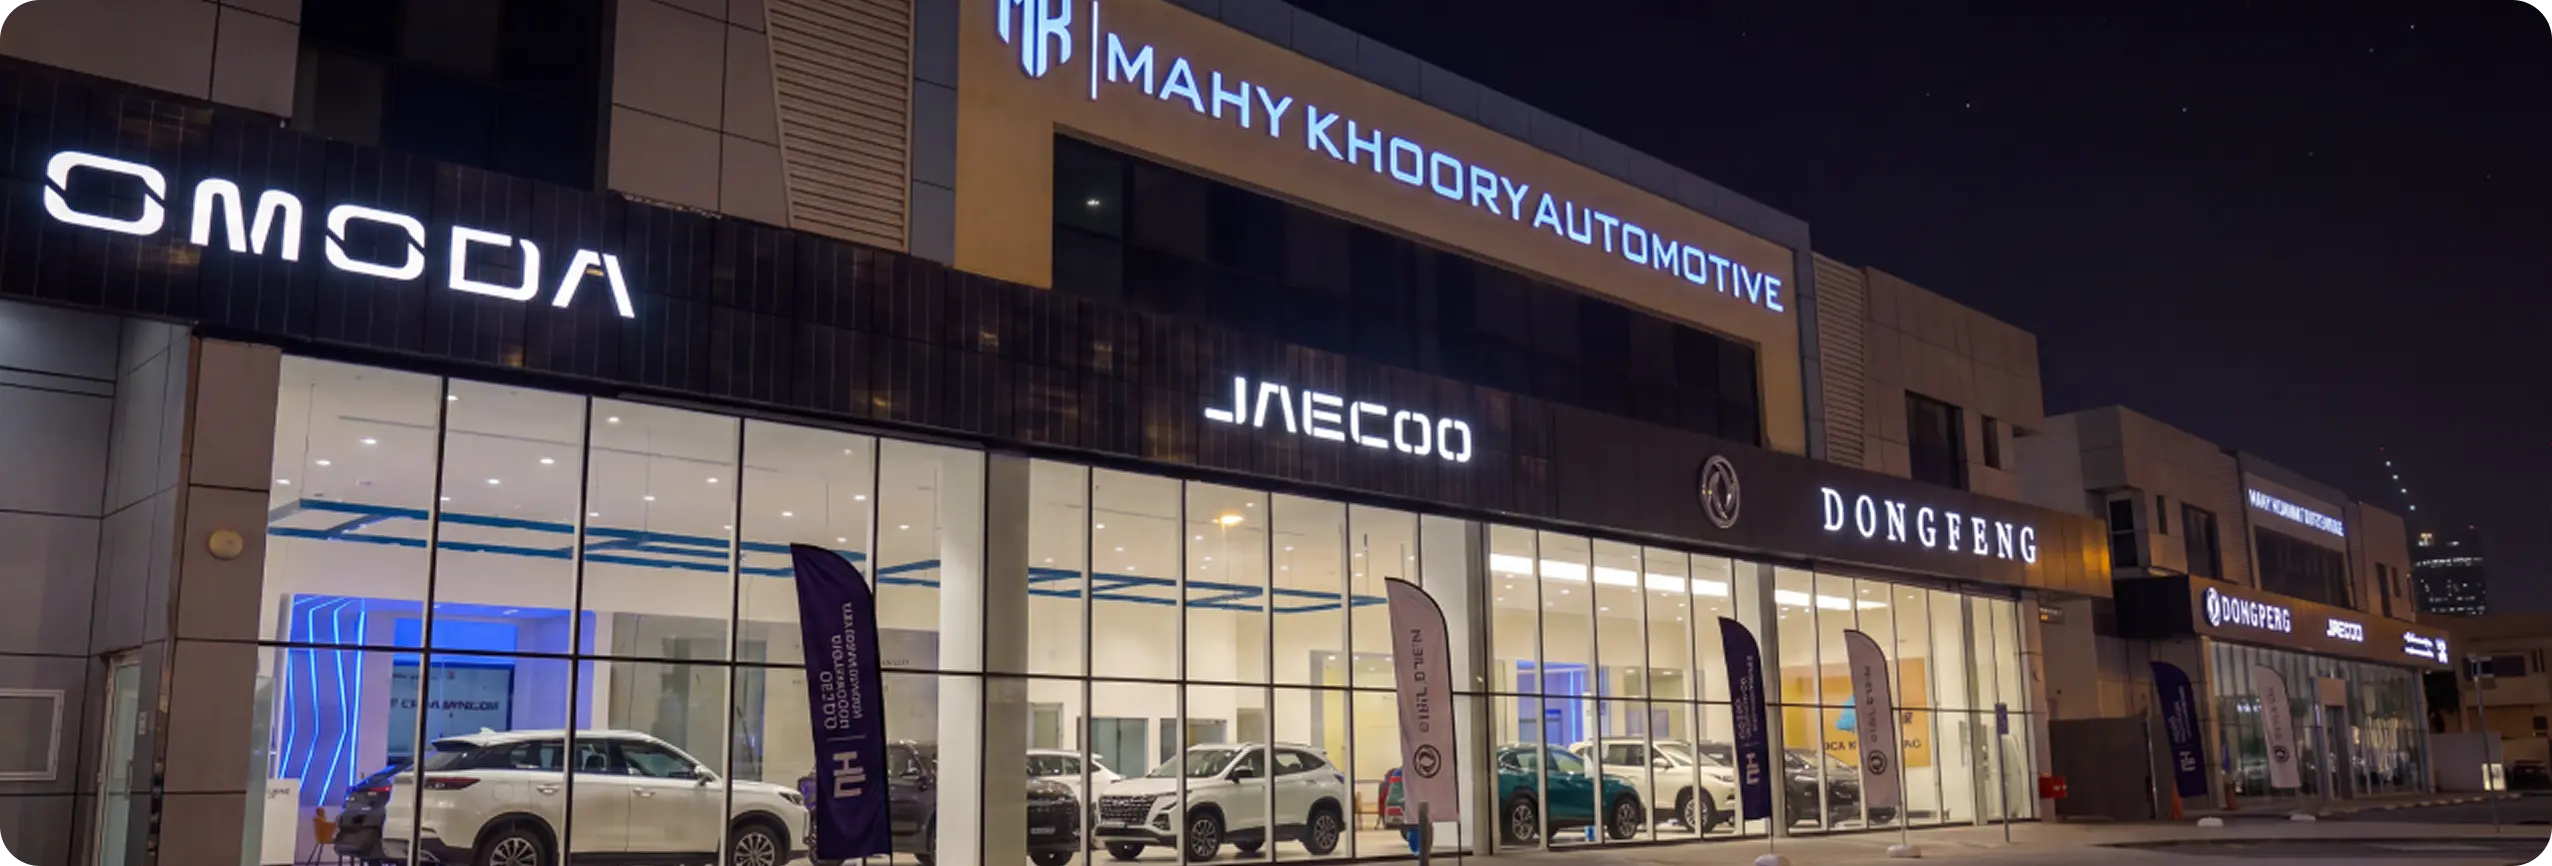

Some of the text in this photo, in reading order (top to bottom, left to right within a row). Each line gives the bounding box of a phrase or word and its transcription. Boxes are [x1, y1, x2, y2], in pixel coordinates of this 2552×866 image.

[43, 150, 636, 319] OMODA
[1107, 32, 1784, 312] MAHY KHOORY AUTOMOTIVE
[1203, 375, 1472, 464] JAECOO
[1820, 486, 2037, 565] DONGFENG
